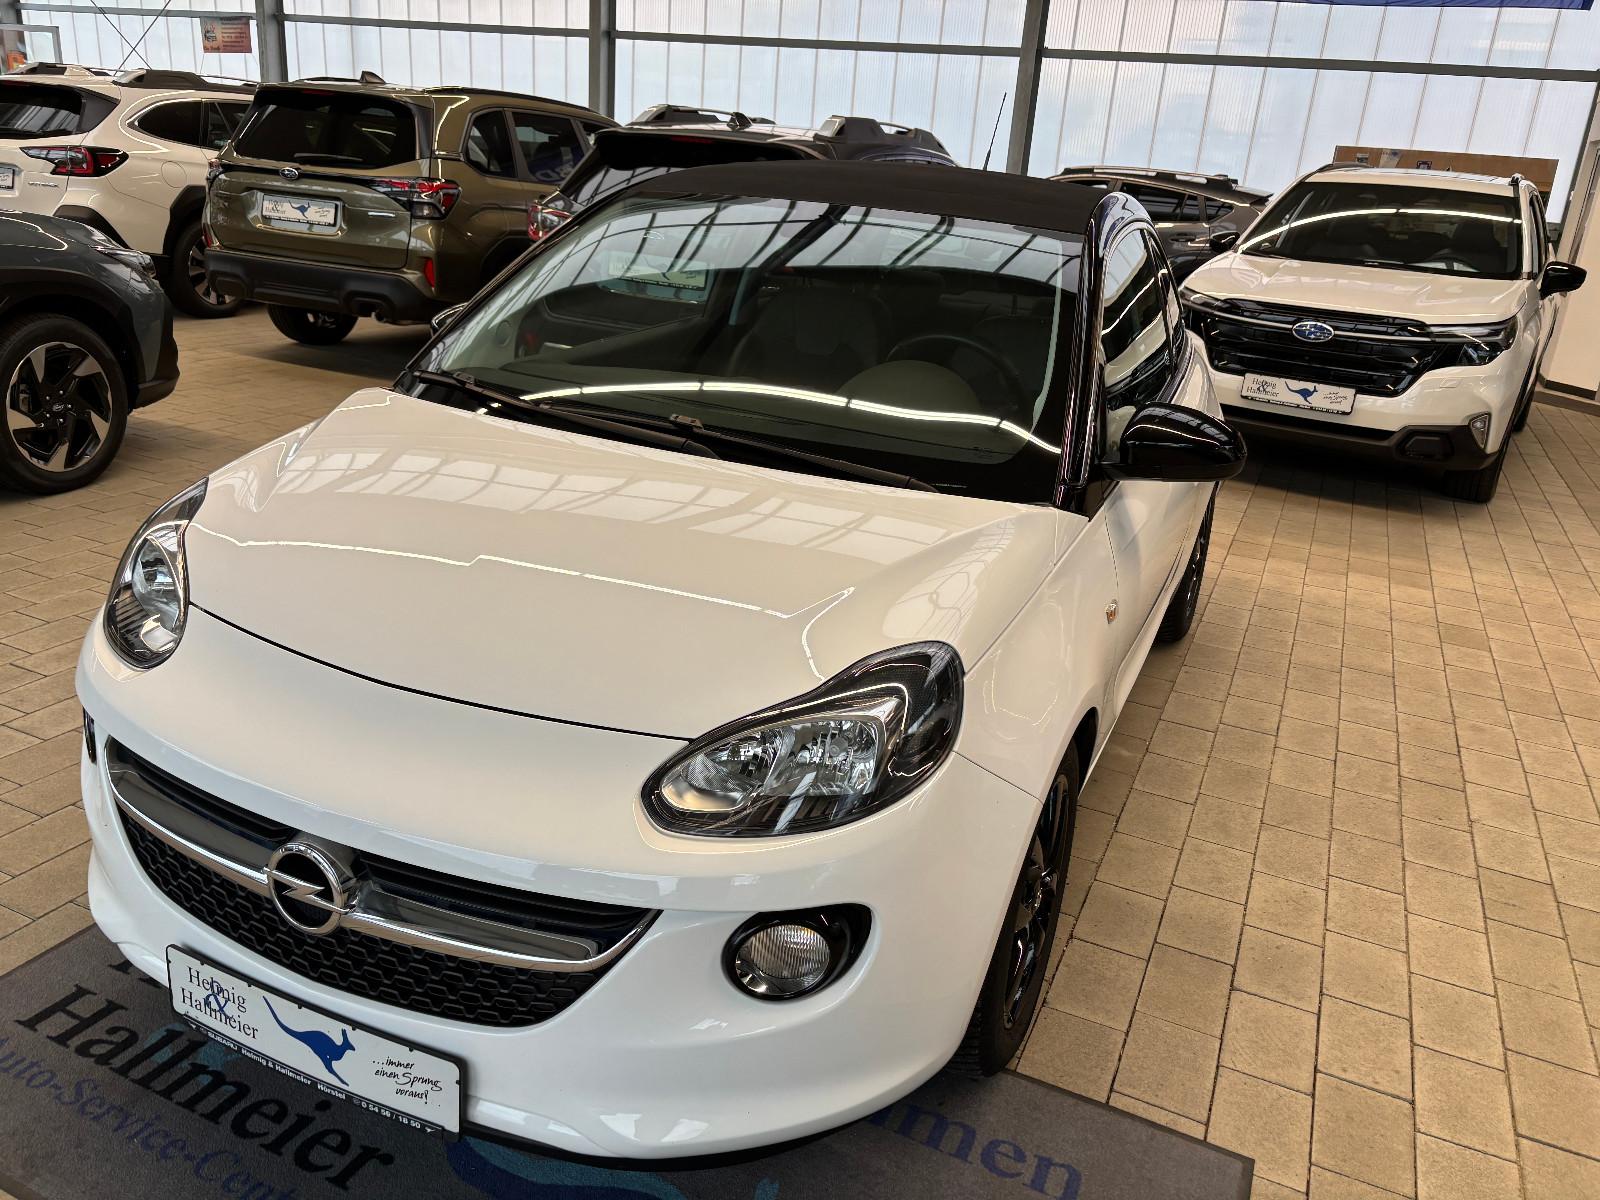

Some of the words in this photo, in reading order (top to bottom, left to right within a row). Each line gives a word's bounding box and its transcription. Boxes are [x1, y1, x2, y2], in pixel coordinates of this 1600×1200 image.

[241, 1047, 267, 1067] Helmig
[275, 1064, 312, 1085] Hallmeier
[374, 1068, 400, 1080] einen
[395, 1072, 443, 1092] Sprung
[14, 983, 395, 1191] Hallmeier
